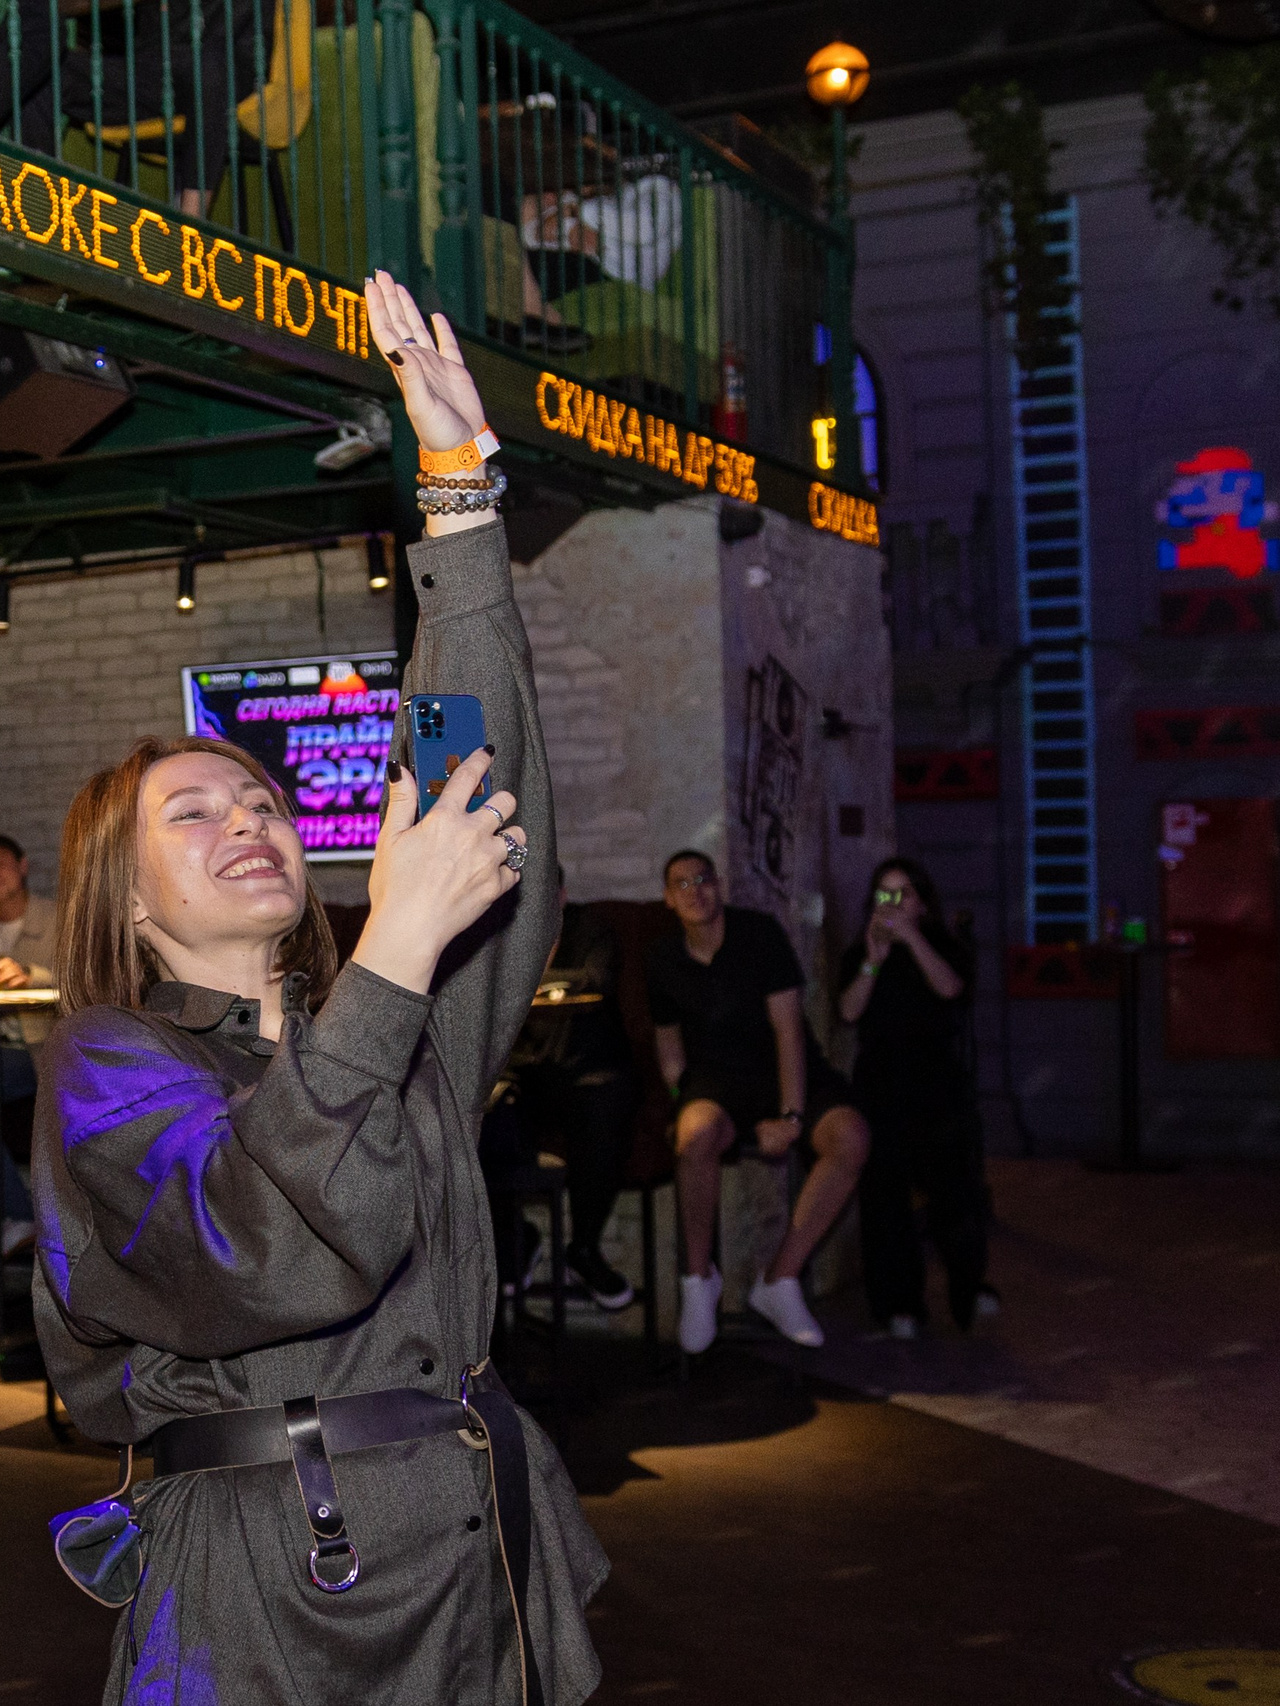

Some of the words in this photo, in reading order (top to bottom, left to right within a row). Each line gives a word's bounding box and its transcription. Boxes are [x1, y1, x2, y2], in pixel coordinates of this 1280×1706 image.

[131, 208, 171, 284] С
[180, 224, 244, 310] ВС
[253, 254, 315, 338] ПО
[535, 371, 646, 464] СКИДКА
[645, 414, 683, 478] НА
[682, 431, 714, 491] ДР
